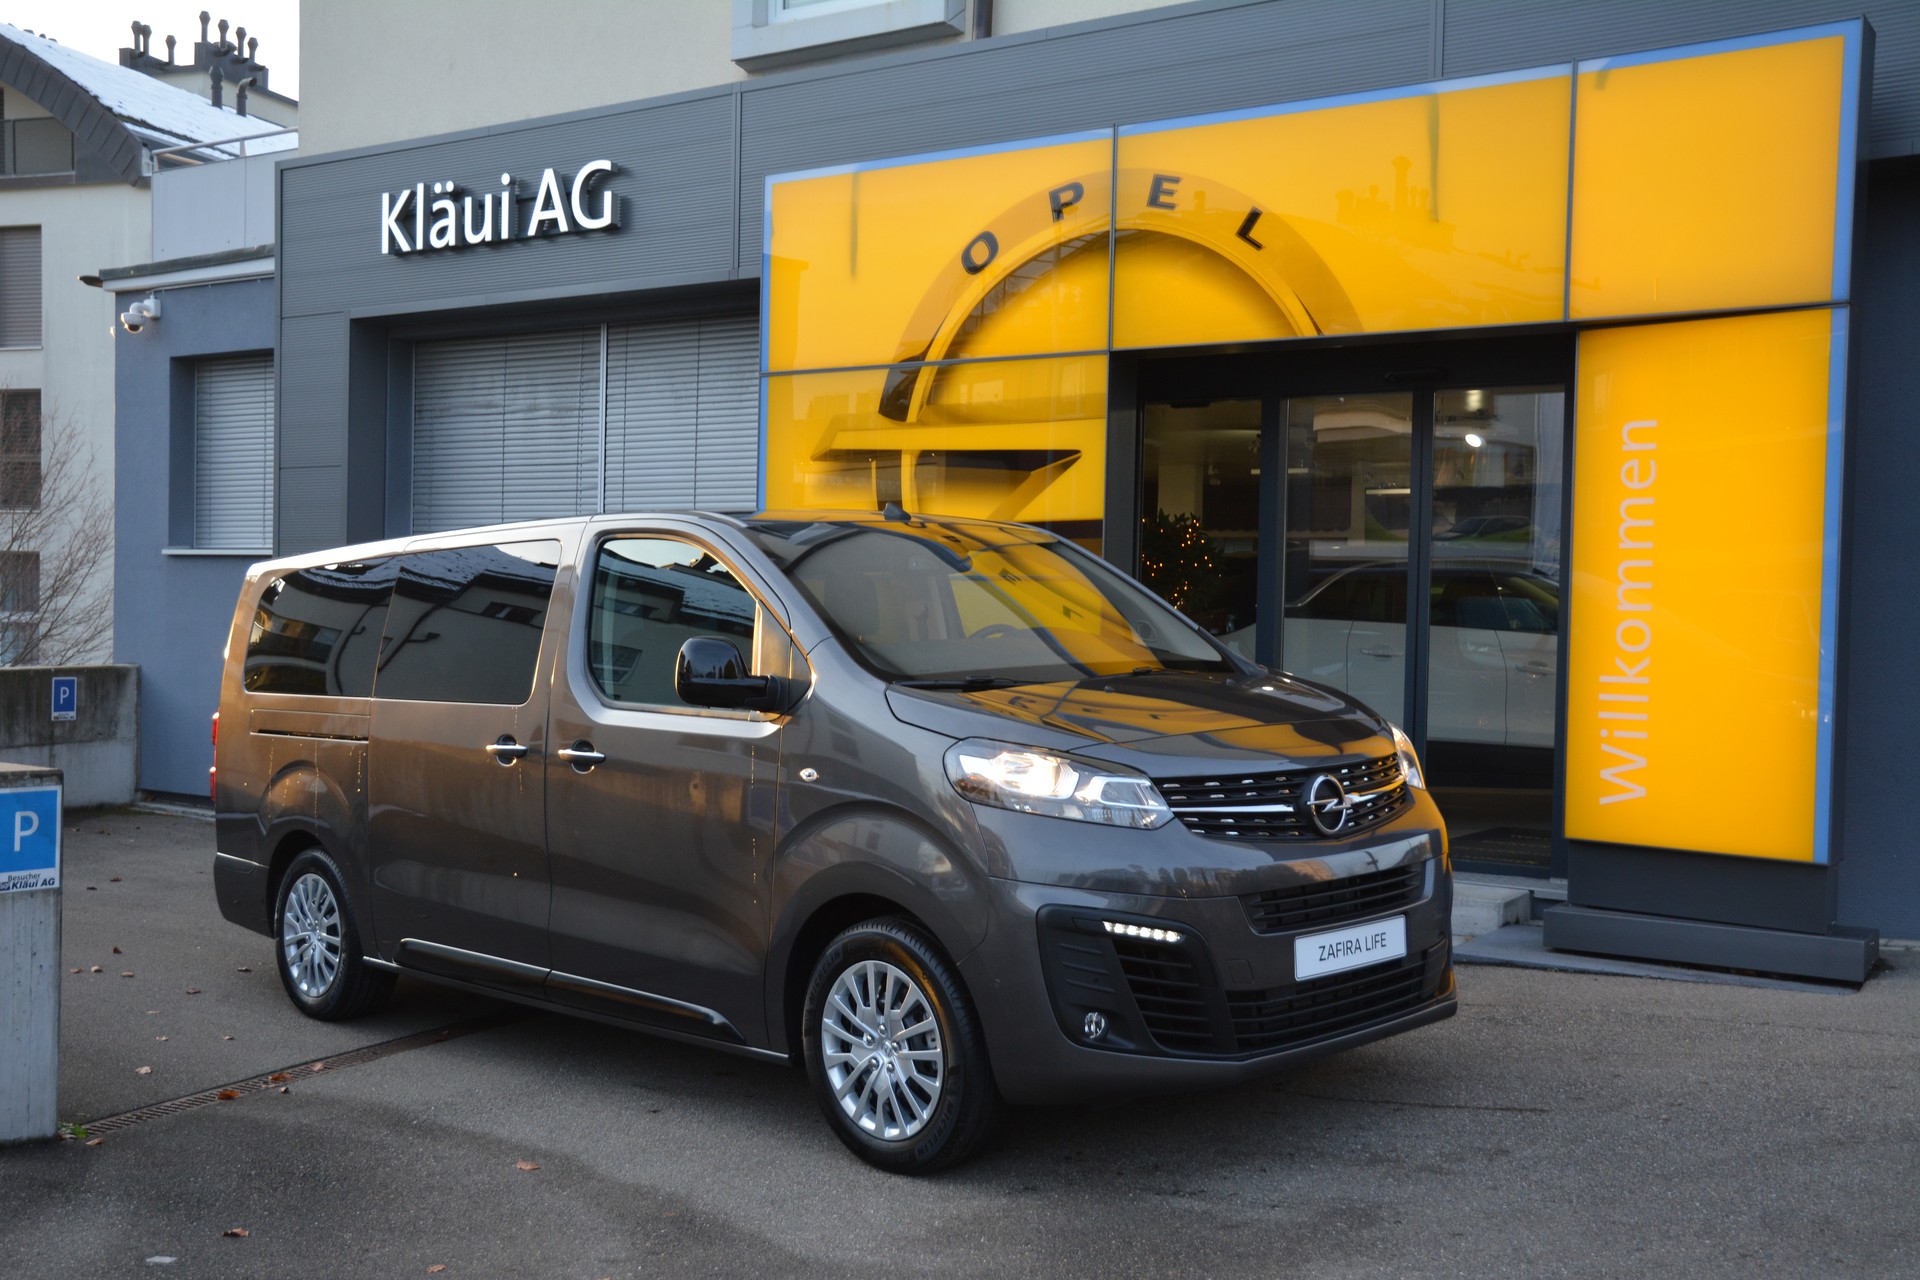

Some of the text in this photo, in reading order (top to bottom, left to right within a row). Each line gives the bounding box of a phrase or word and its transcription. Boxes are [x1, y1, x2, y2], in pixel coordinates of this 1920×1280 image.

[381, 159, 613, 255] Kläui AG
[960, 173, 1266, 275] OPEL
[1598, 419, 1658, 805] Willkommen
[60, 686, 70, 705] P
[13, 810, 39, 852] P
[7, 873, 41, 882] Besucher
[40, 877, 56, 887] AG
[1318, 932, 1387, 961] ZAFIRA LIFE
[809, 947, 842, 1005] MICHELIN
[917, 1099, 954, 1157] MICHELIN
